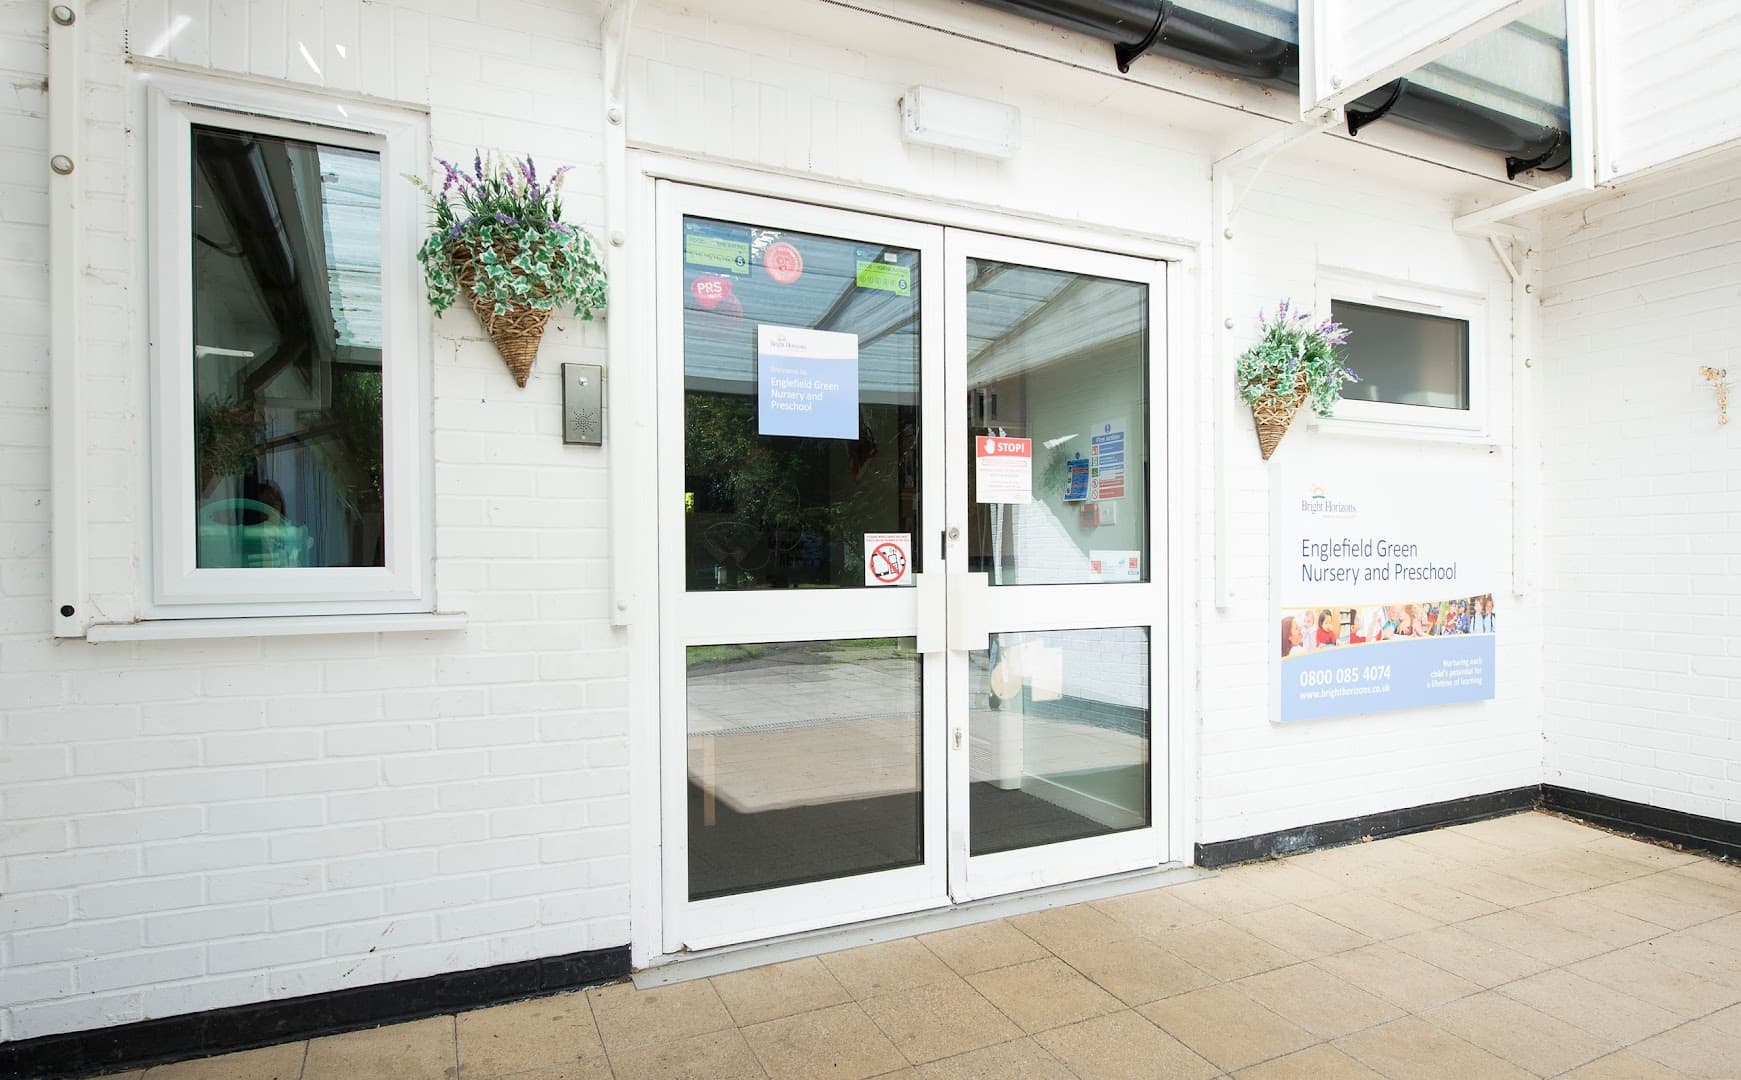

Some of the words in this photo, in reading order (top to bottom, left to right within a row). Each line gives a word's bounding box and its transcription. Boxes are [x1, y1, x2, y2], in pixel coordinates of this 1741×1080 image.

[697, 281, 723, 296] PRS
[771, 377, 813, 390] Englefield
[814, 381, 840, 392] Green
[771, 389, 805, 401] Nursery
[806, 392, 823, 401] and
[771, 400, 812, 412] Preschool
[997, 442, 1025, 454] STOP!
[1301, 499, 1324, 515] Bright
[1325, 500, 1357, 514] Horizons
[1302, 538, 1373, 562] Englefield
[1376, 539, 1418, 558] Green
[1302, 563, 1360, 586] Nursery
[1364, 563, 1390, 582] and
[1394, 562, 1457, 581] Preschool
[1300, 669, 1333, 687] 0800
[1336, 667, 1359, 684] 085
[1362, 665, 1392, 682] 4074
[1300, 684, 1391, 700] www.brighthorizons.co.uk
